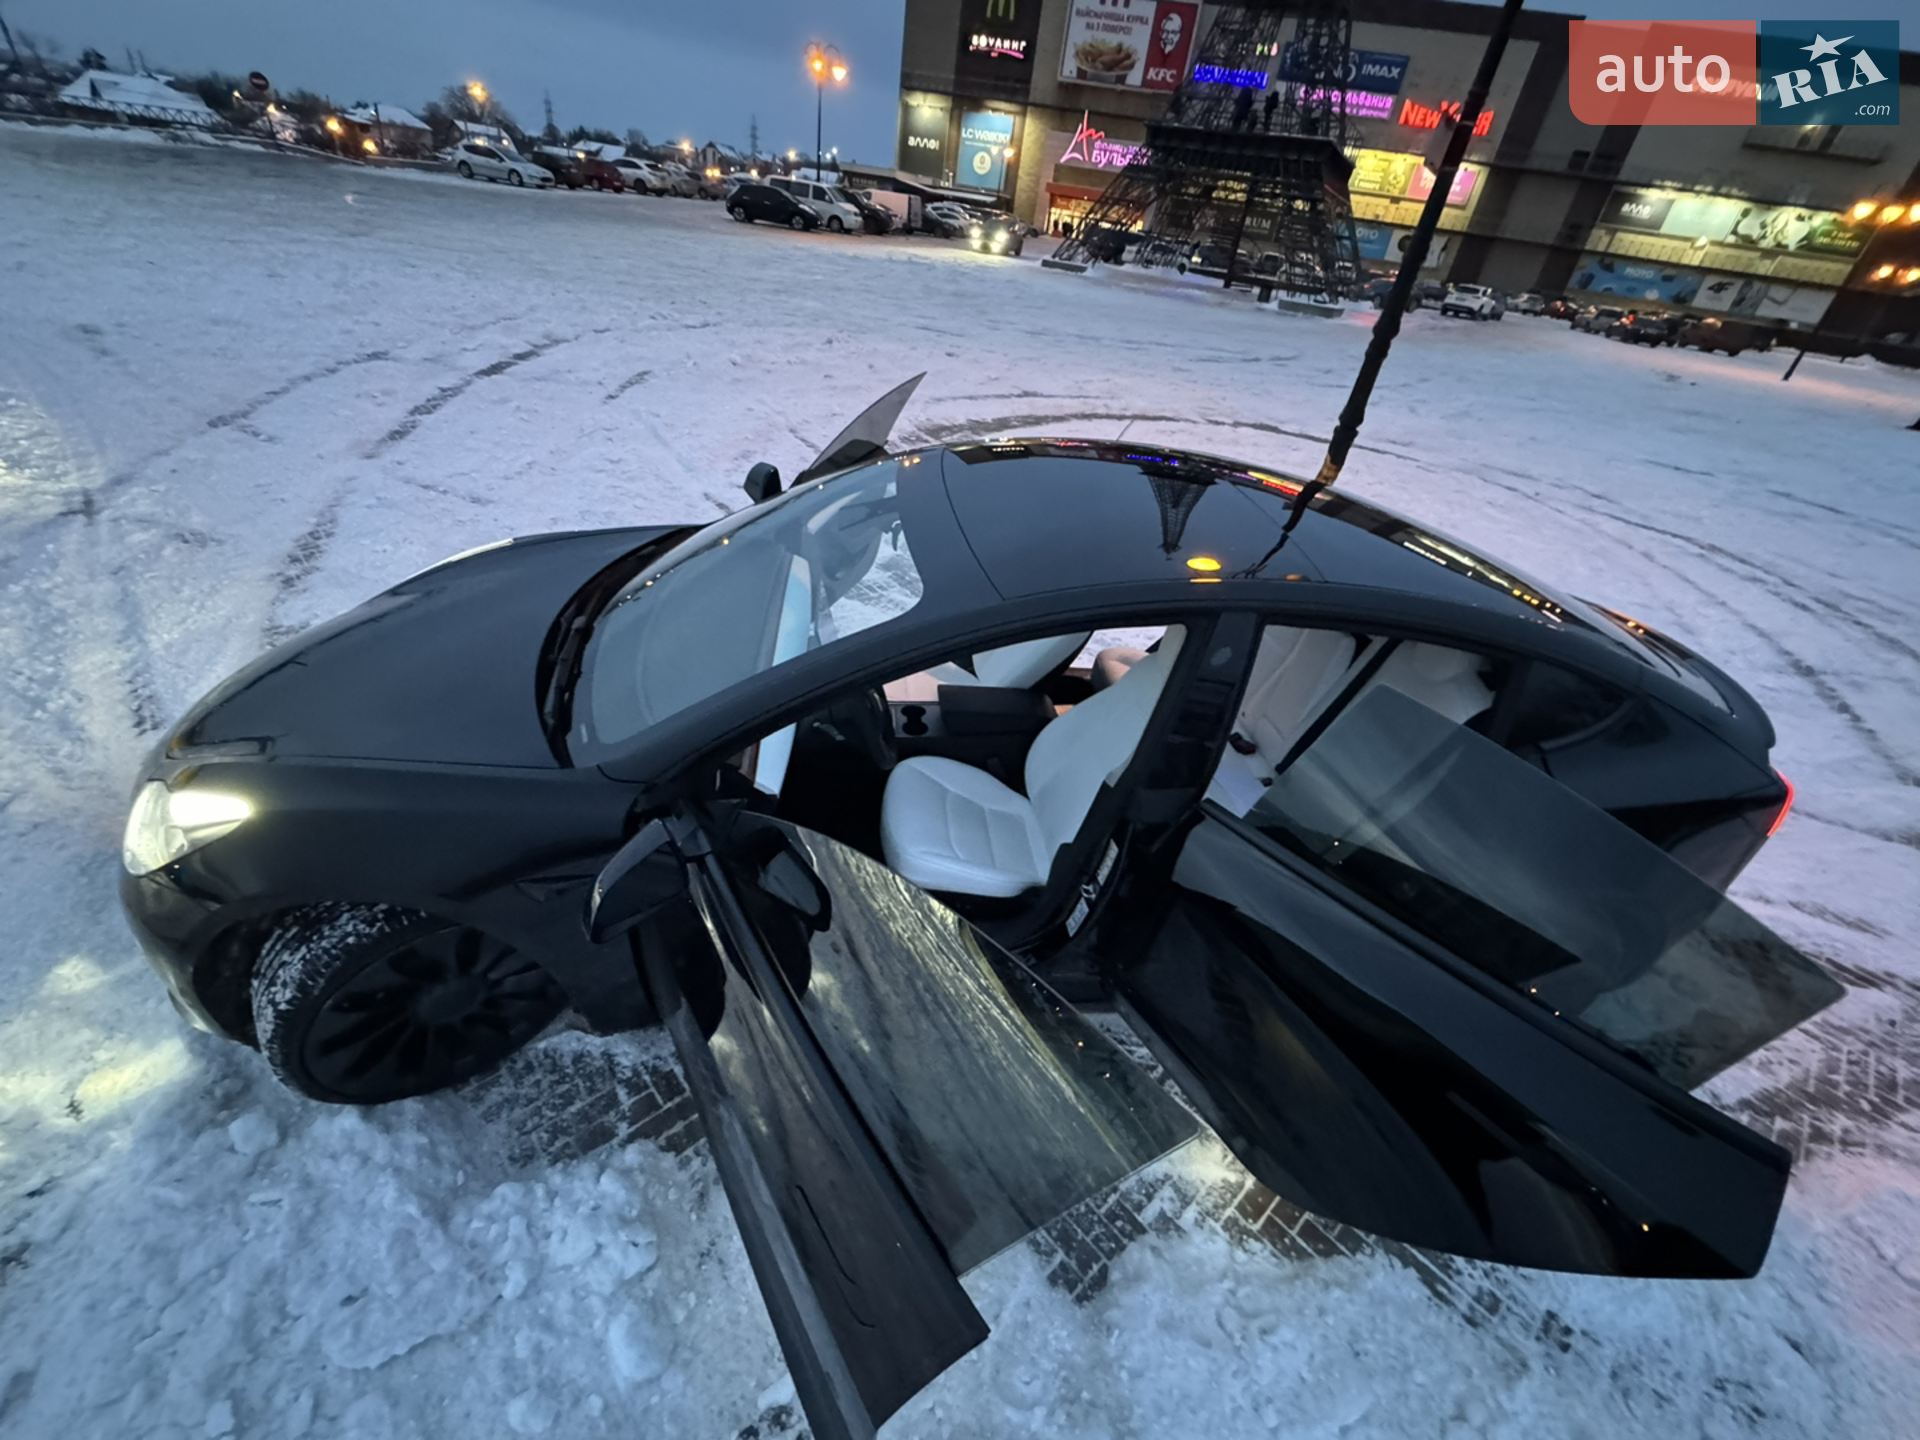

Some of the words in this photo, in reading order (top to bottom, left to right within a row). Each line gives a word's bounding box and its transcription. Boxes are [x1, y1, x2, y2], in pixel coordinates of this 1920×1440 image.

[1146, 66, 1177, 83] KFC
[1361, 63, 1400, 79] IMAX
[1398, 98, 1442, 130] NEW
[961, 127, 974, 139] LC
[1091, 150, 1149, 168] БУЛЬ
[1355, 227, 1379, 240] OYO
